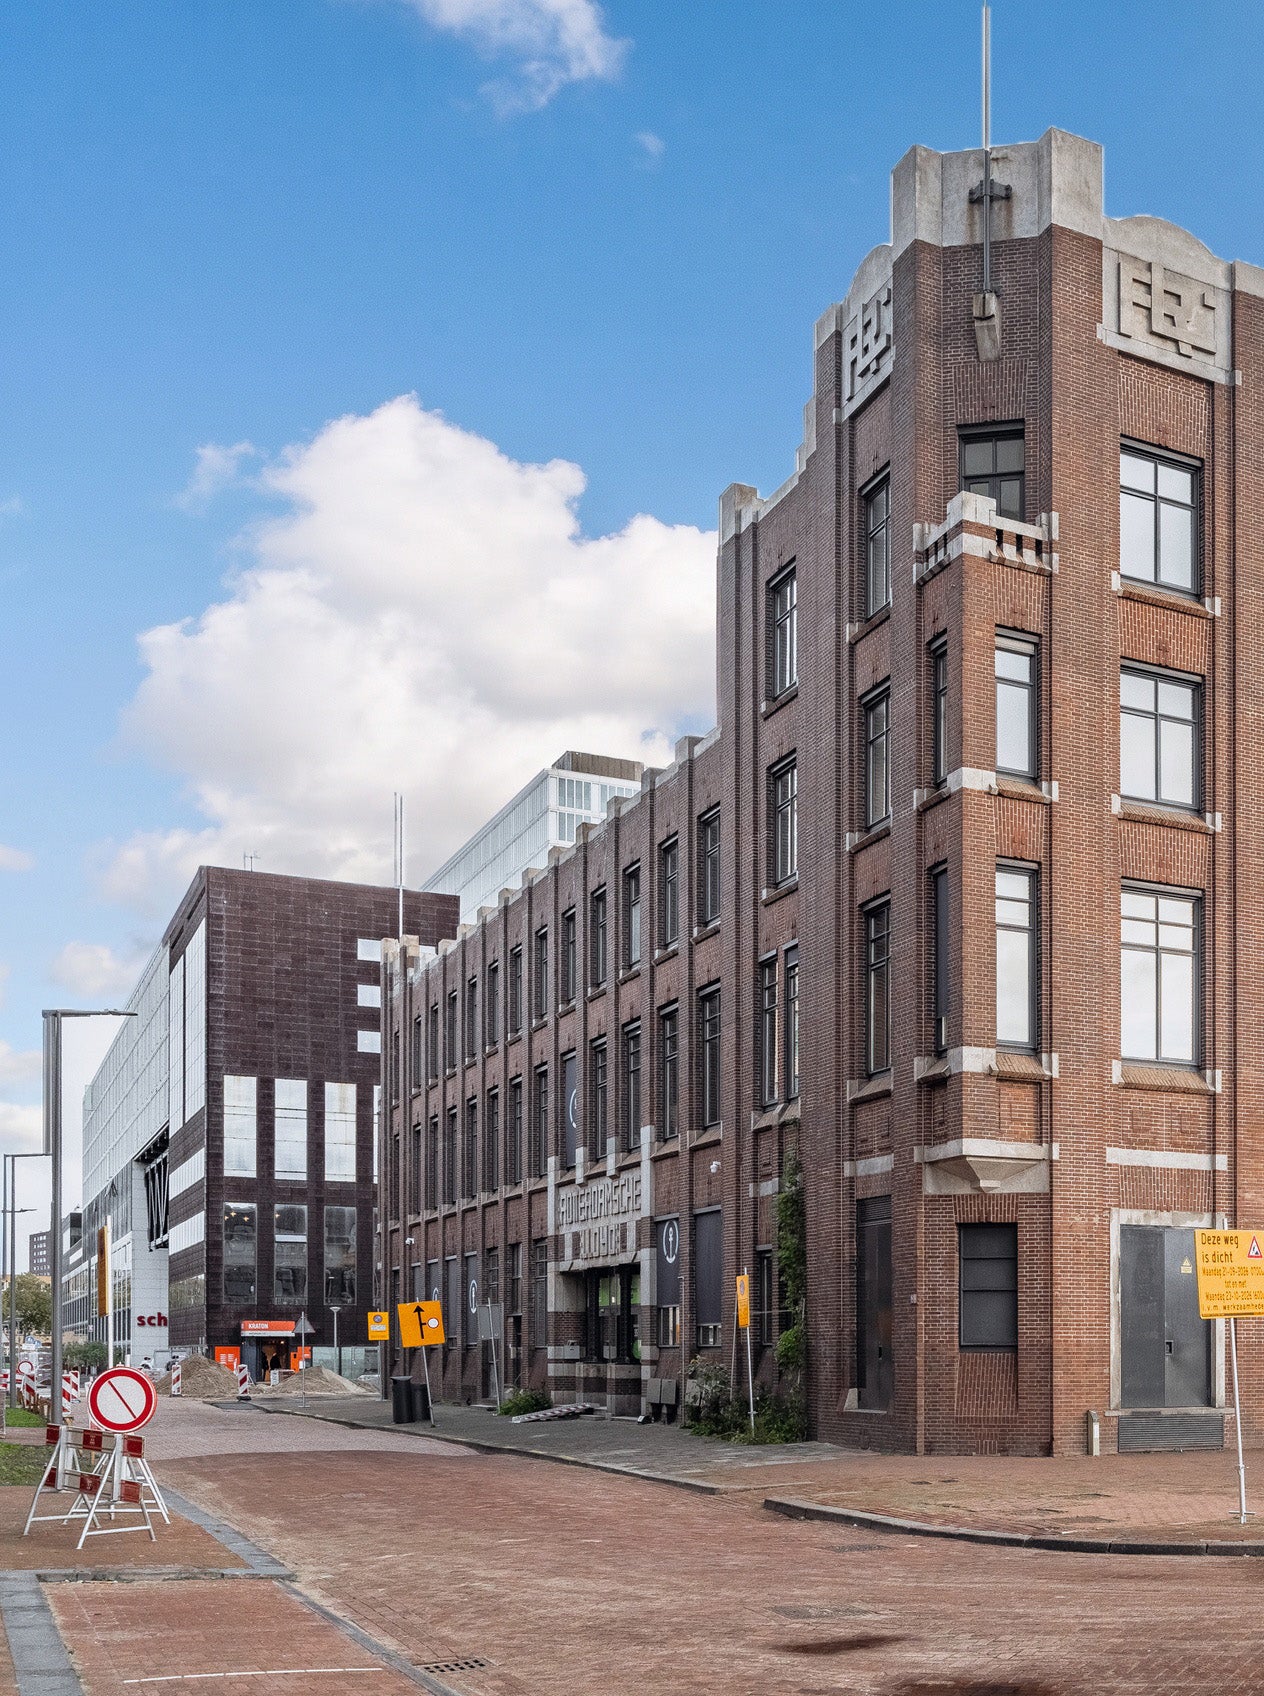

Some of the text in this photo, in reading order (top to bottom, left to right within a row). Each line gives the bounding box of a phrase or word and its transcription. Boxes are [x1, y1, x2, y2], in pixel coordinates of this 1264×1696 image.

[1201, 1232, 1239, 1249] Deze weg
[1201, 1251, 1233, 1263] is dicht
[137, 1311, 168, 1327] sch
